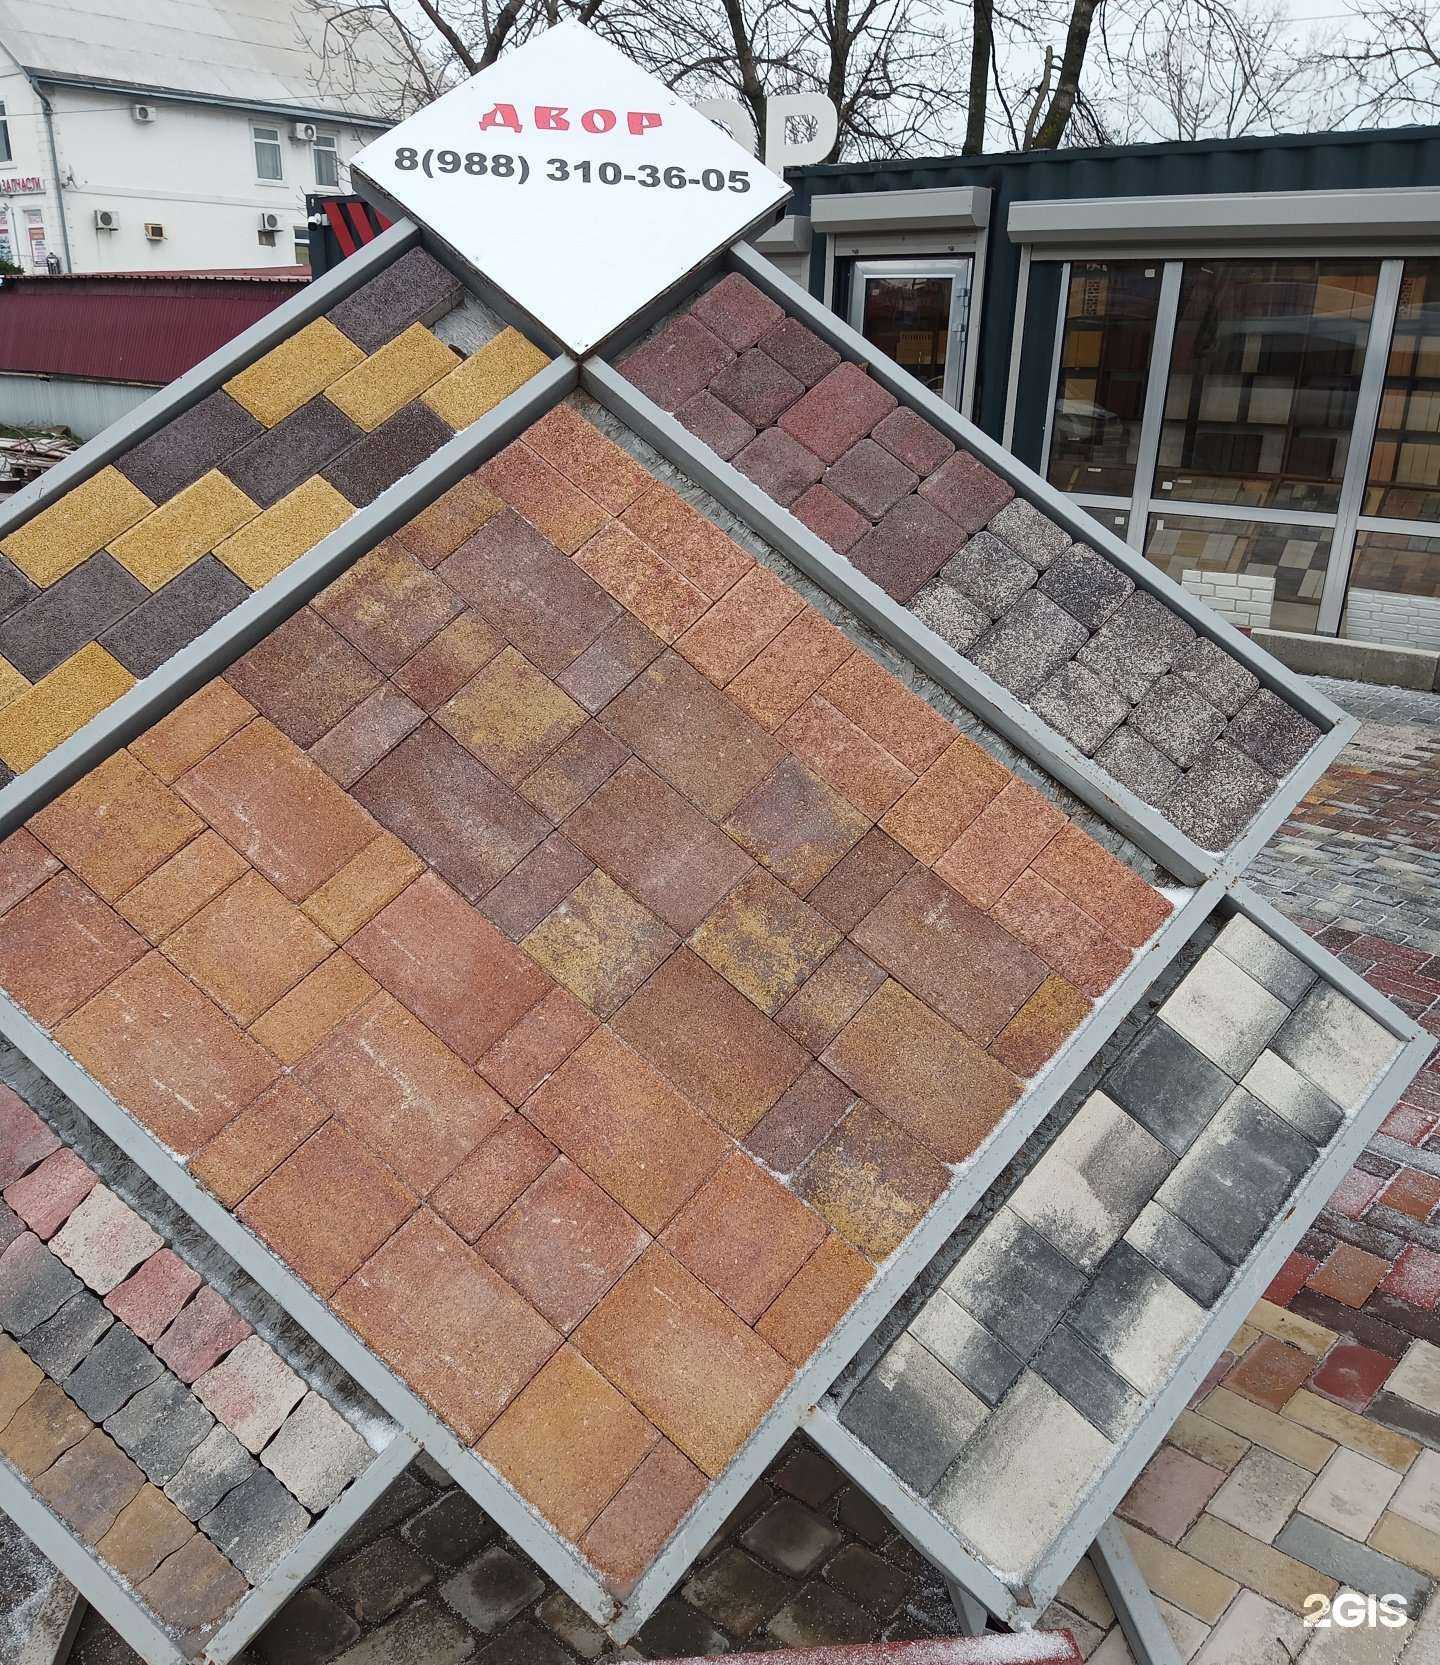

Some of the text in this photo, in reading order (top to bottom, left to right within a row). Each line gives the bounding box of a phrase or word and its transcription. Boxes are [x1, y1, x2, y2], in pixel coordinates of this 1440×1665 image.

[478, 103, 663, 136] ДВОР
[0, 177, 41, 192] ЗАПЧАСТИ
[394, 147, 751, 194] 8(988) 310-36-05
